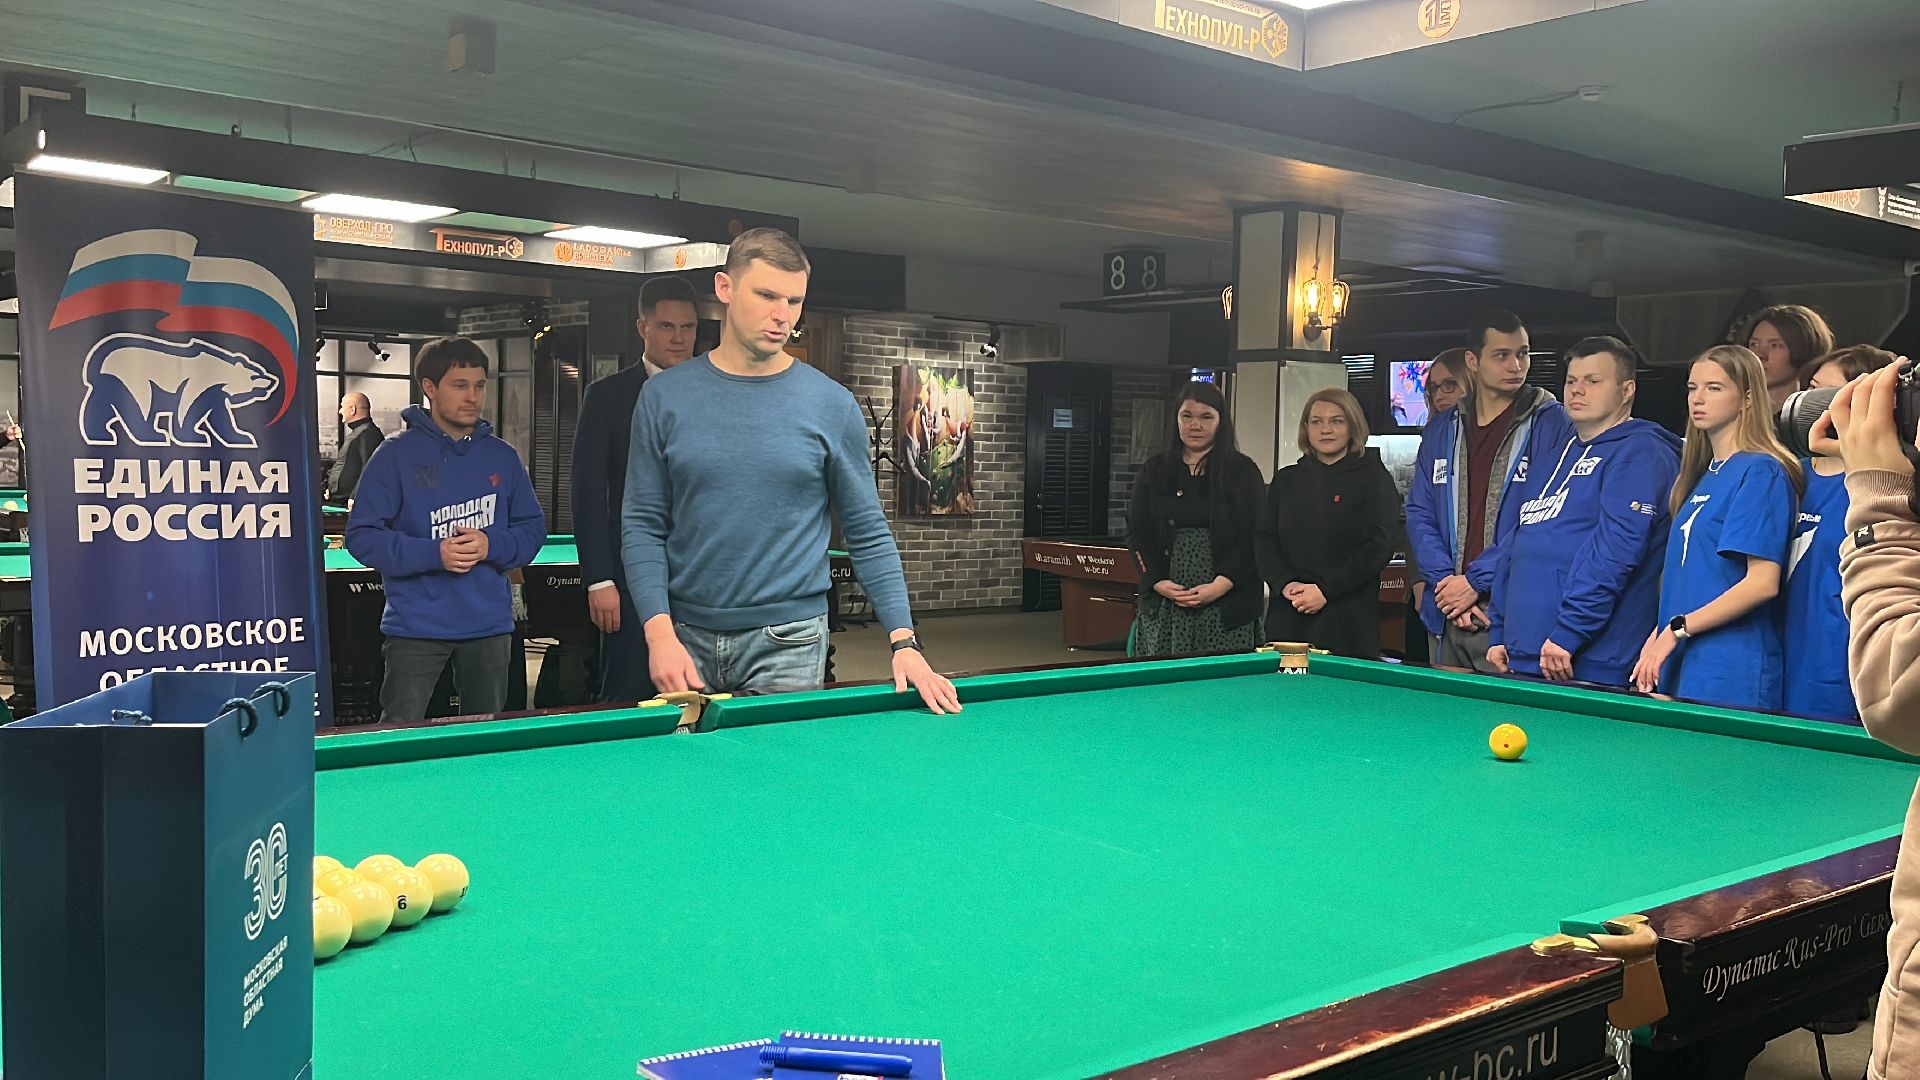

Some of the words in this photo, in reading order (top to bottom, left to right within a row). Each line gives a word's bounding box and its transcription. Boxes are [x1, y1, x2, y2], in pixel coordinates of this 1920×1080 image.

[429, 227, 506, 257] ТЕХНОПУЛ-Р
[1110, 255, 1126, 291] 8
[1142, 255, 1157, 290] 8
[73, 458, 290, 499] ЕДИНАЯ
[77, 503, 292, 543] РОССИЯ
[430, 493, 497, 525] МОЛОДАЯ
[547, 576, 581, 588] Dynam
[831, 567, 851, 578] c.ru
[1379, 577, 1405, 589] ramith
[79, 617, 305, 658] МОСКОВСКОЕ
[244, 822, 288, 940] 30
[397, 895, 407, 910] 6
[243, 935, 289, 989] МОСКОВСКАЯ
[1702, 948, 1782, 1002] Dynamic
[243, 956, 285, 1007] ОБЛАСТНАЯ
[243, 996, 265, 1029] ДУМА
